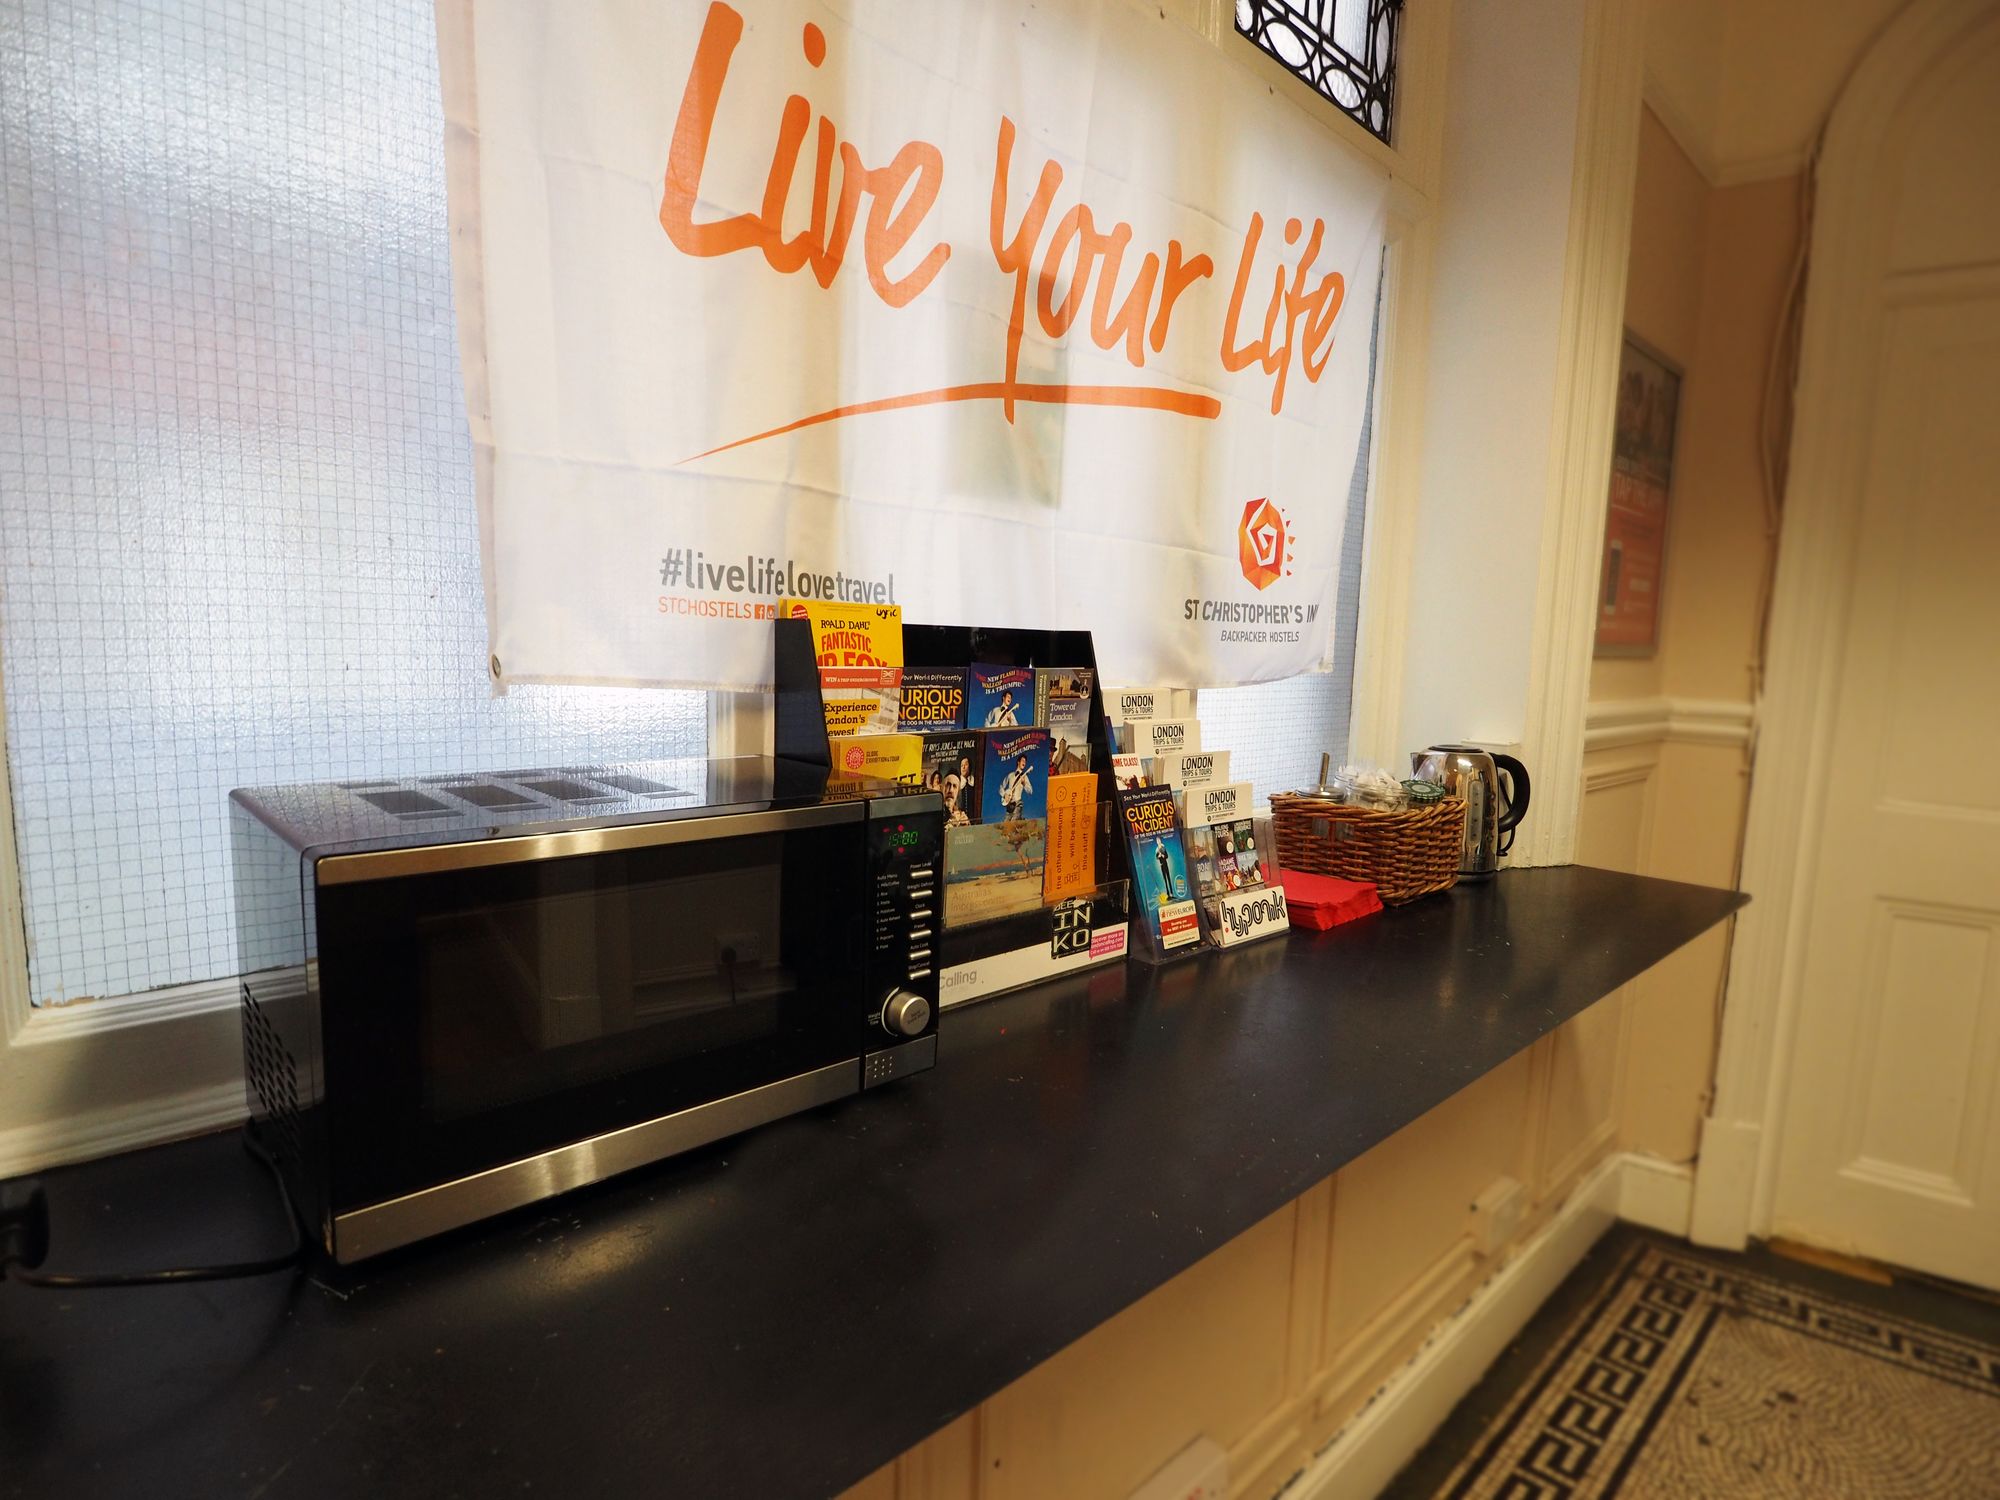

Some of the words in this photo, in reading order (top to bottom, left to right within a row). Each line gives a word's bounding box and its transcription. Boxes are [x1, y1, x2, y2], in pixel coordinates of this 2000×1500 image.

[659, 0, 951, 309] Live
[990, 114, 1213, 425] Your
[1220, 211, 1345, 415] Life
[659, 548, 896, 605] #livelifelovetravel
[658, 596, 752, 619] STCHOSTELS
[1184, 599, 1200, 620] ST
[1202, 600, 1304, 624] CHRISTOPHER'S
[820, 620, 846, 629] ROALD
[821, 631, 872, 653] FANTASTIC
[1220, 630, 1267, 642] BACKPACKER
[1269, 631, 1300, 643] HOSTELS
[900, 689, 963, 706] URIOUS
[1121, 695, 1154, 708] LONDON
[824, 702, 877, 714] Experience
[899, 706, 958, 720] NCIDENT
[1050, 703, 1069, 712] Tower
[1069, 702, 1077, 711] of
[826, 714, 866, 725] ondon's
[1049, 712, 1073, 721] London
[828, 728, 855, 736] ewest
[1152, 725, 1184, 739] LONDON
[1181, 756, 1214, 770] LONDON
[1204, 789, 1237, 806] LONDON
[1126, 801, 1174, 822] CURIOUS
[1205, 805, 1218, 813] TRIPS
[1222, 803, 1236, 811] TOURS
[1131, 815, 1174, 833] INCIDENT
